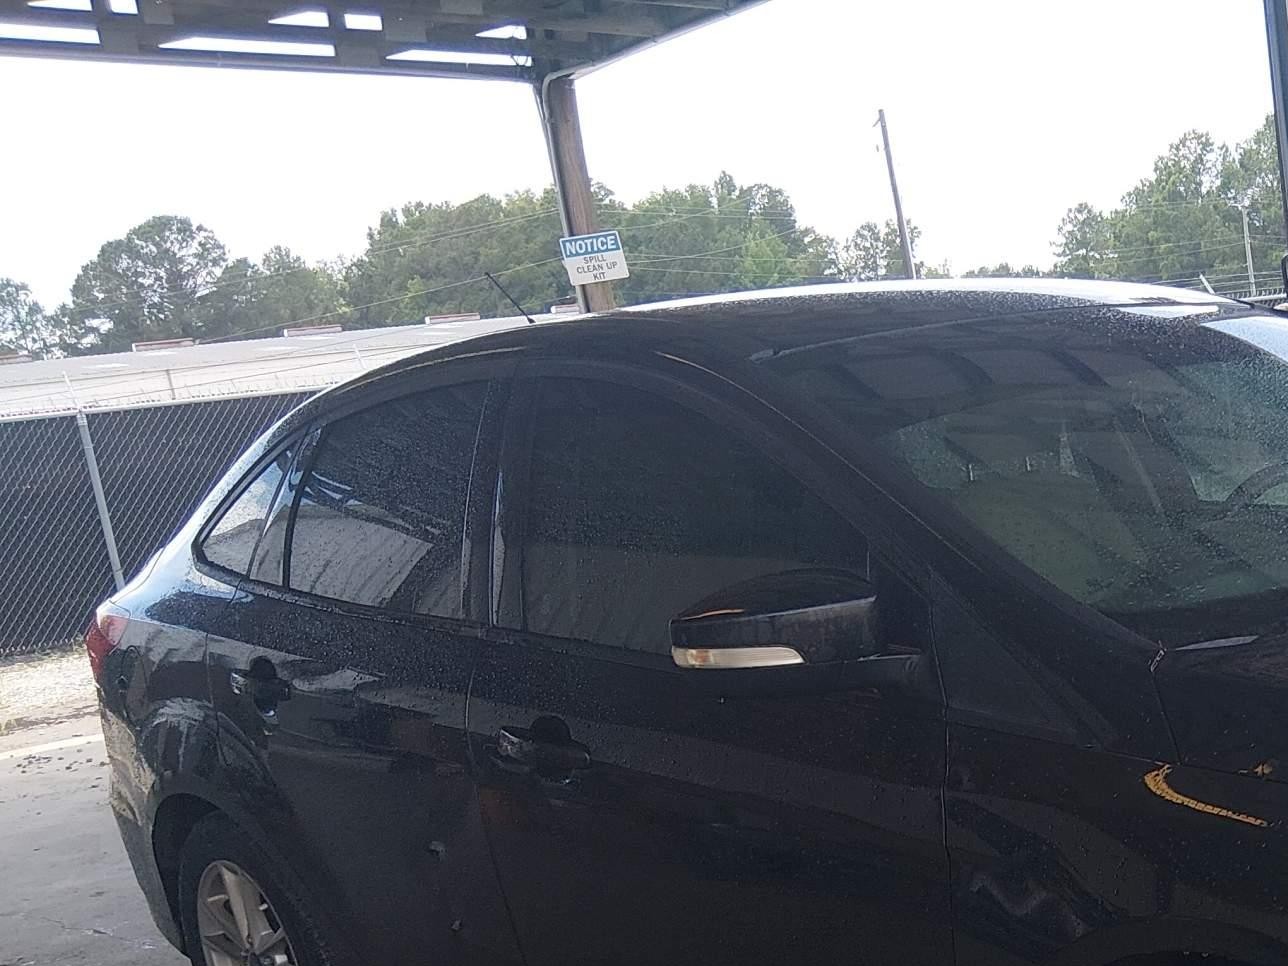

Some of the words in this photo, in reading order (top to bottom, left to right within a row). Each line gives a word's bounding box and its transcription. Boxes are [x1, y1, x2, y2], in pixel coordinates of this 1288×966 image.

[565, 235, 617, 255] NOTICE
[584, 254, 607, 264] SPILL
[576, 263, 604, 274] CLEAN
[606, 261, 618, 270] UP
[593, 272, 607, 280] KIT
